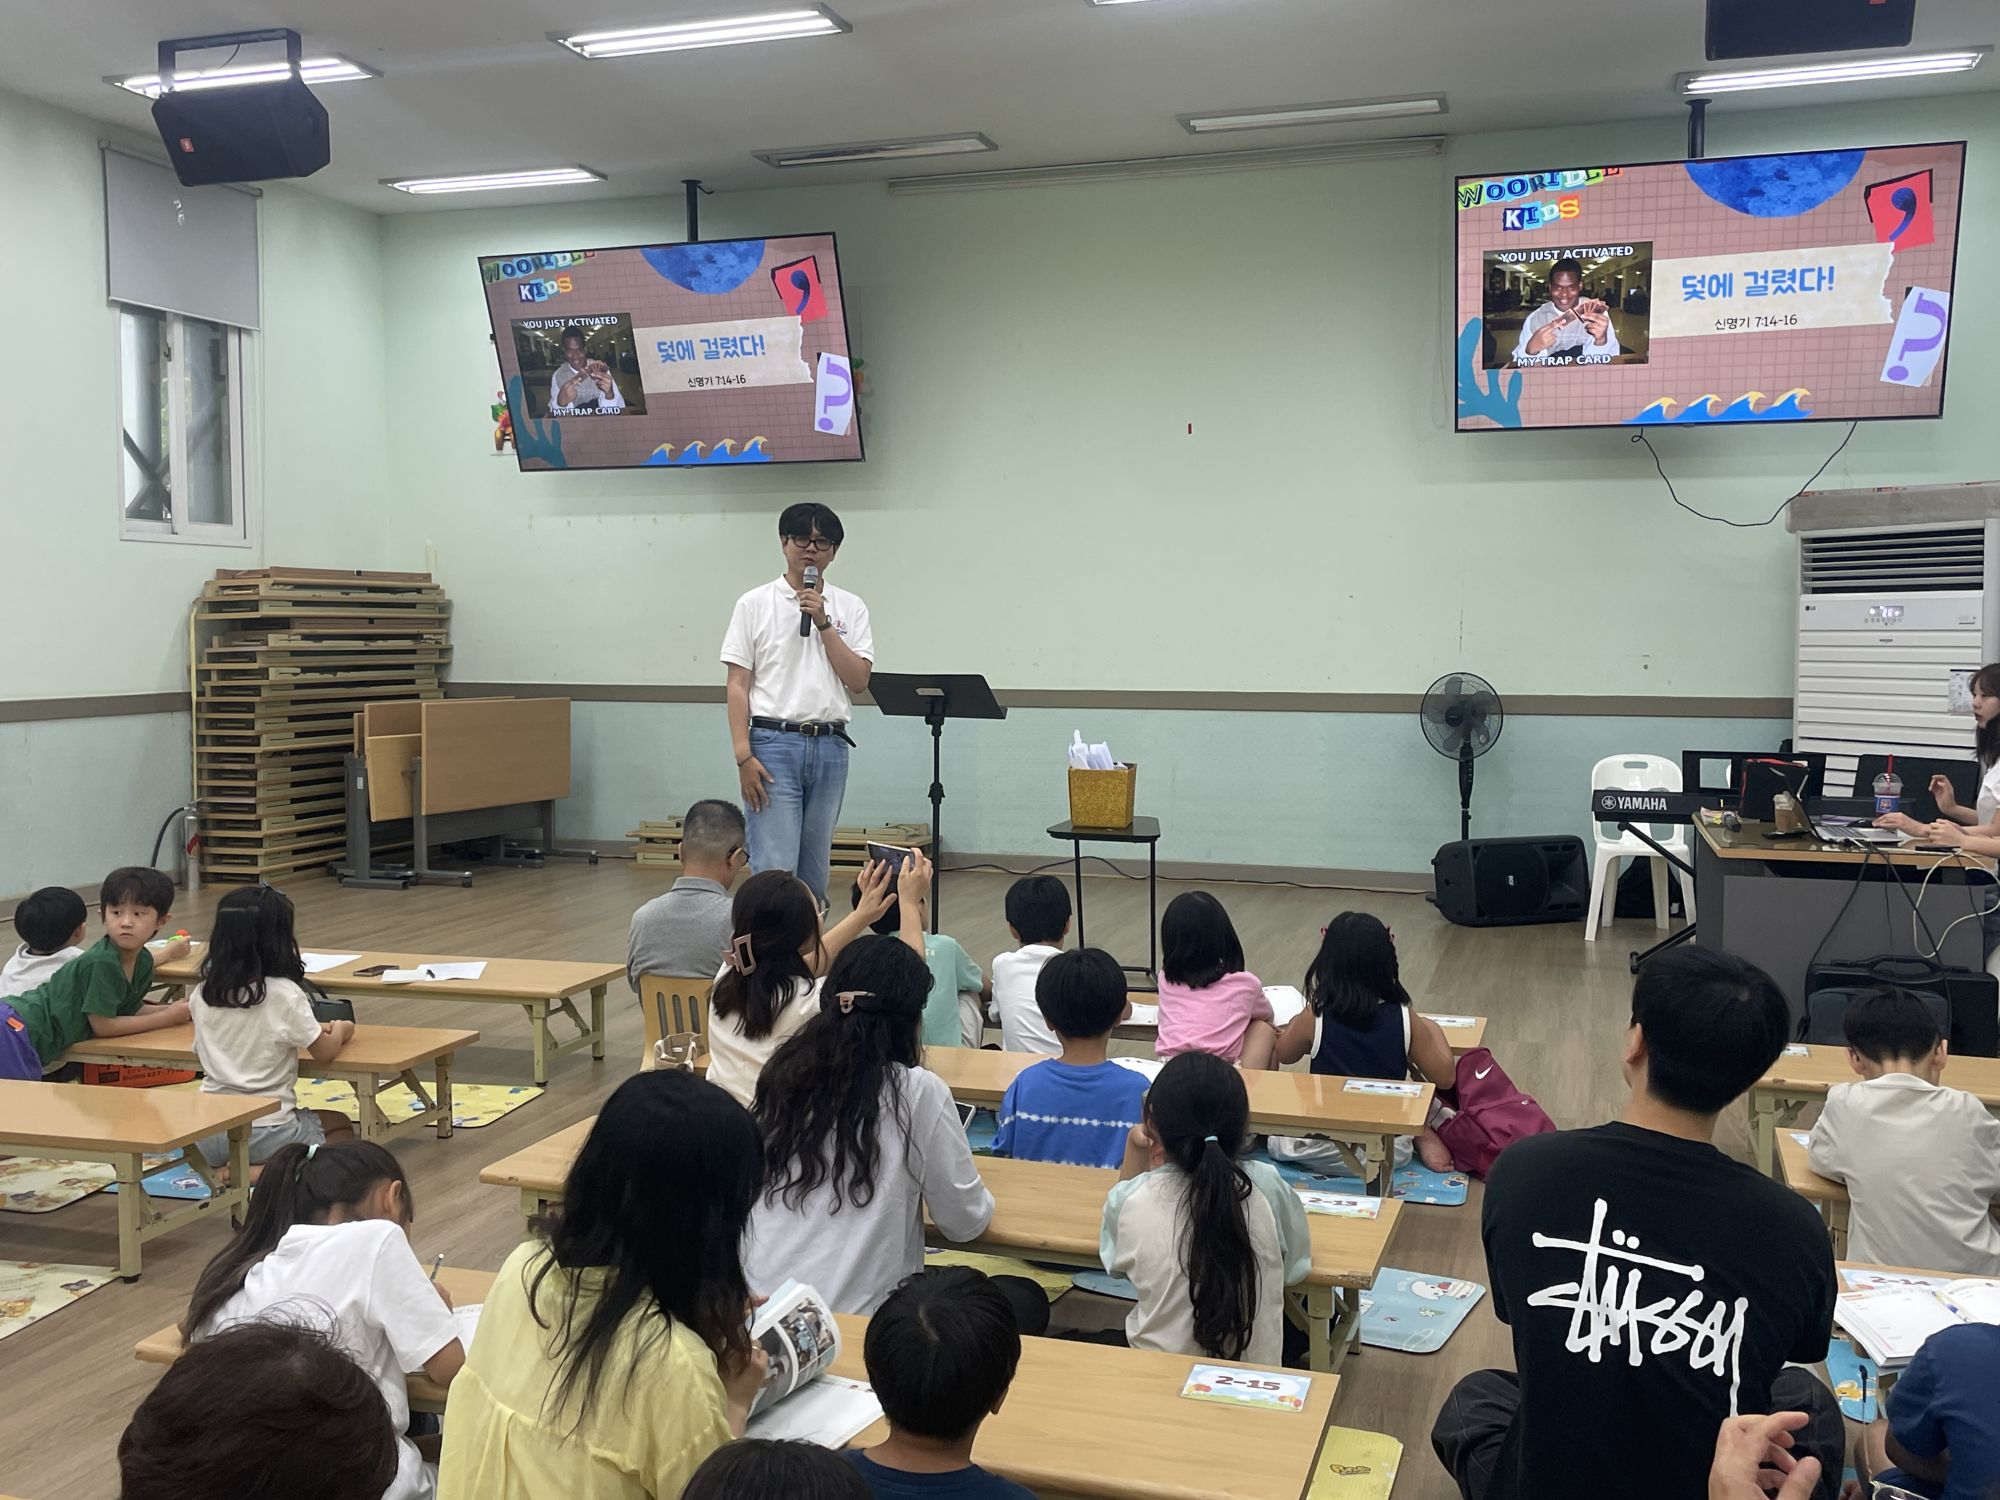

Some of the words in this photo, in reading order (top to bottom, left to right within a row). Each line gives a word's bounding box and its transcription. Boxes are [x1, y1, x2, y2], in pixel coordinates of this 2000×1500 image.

[1504, 199, 1581, 229] KIDS
[1501, 252, 1526, 263] YOU
[1530, 250, 1561, 264] JUST
[1563, 245, 1634, 260] ACTIVATED
[520, 277, 573, 301] KIDS
[1681, 272, 1734, 302] 덫에
[1743, 265, 1836, 298] 걸렸다!
[523, 320, 542, 330] YOU
[545, 319, 566, 330] JUST
[568, 316, 618, 327] ACTIVATED
[1714, 316, 1751, 331] 신명기
[1754, 313, 1798, 328] 7:14-16
[656, 339, 696, 364] 덫에
[699, 334, 766, 361] 걸렸다!
[1517, 357, 1538, 367] MY
[1540, 355, 1573, 366] TRAP
[1576, 354, 1612, 365] CARD
[687, 376, 714, 388] 신명기
[553, 408, 567, 417] MY
[569, 407, 593, 416] TRAP
[595, 406, 621, 416] CARD
[1617, 796, 1668, 811] YAMAHA
[1215, 1375, 1281, 1391] 2-15
